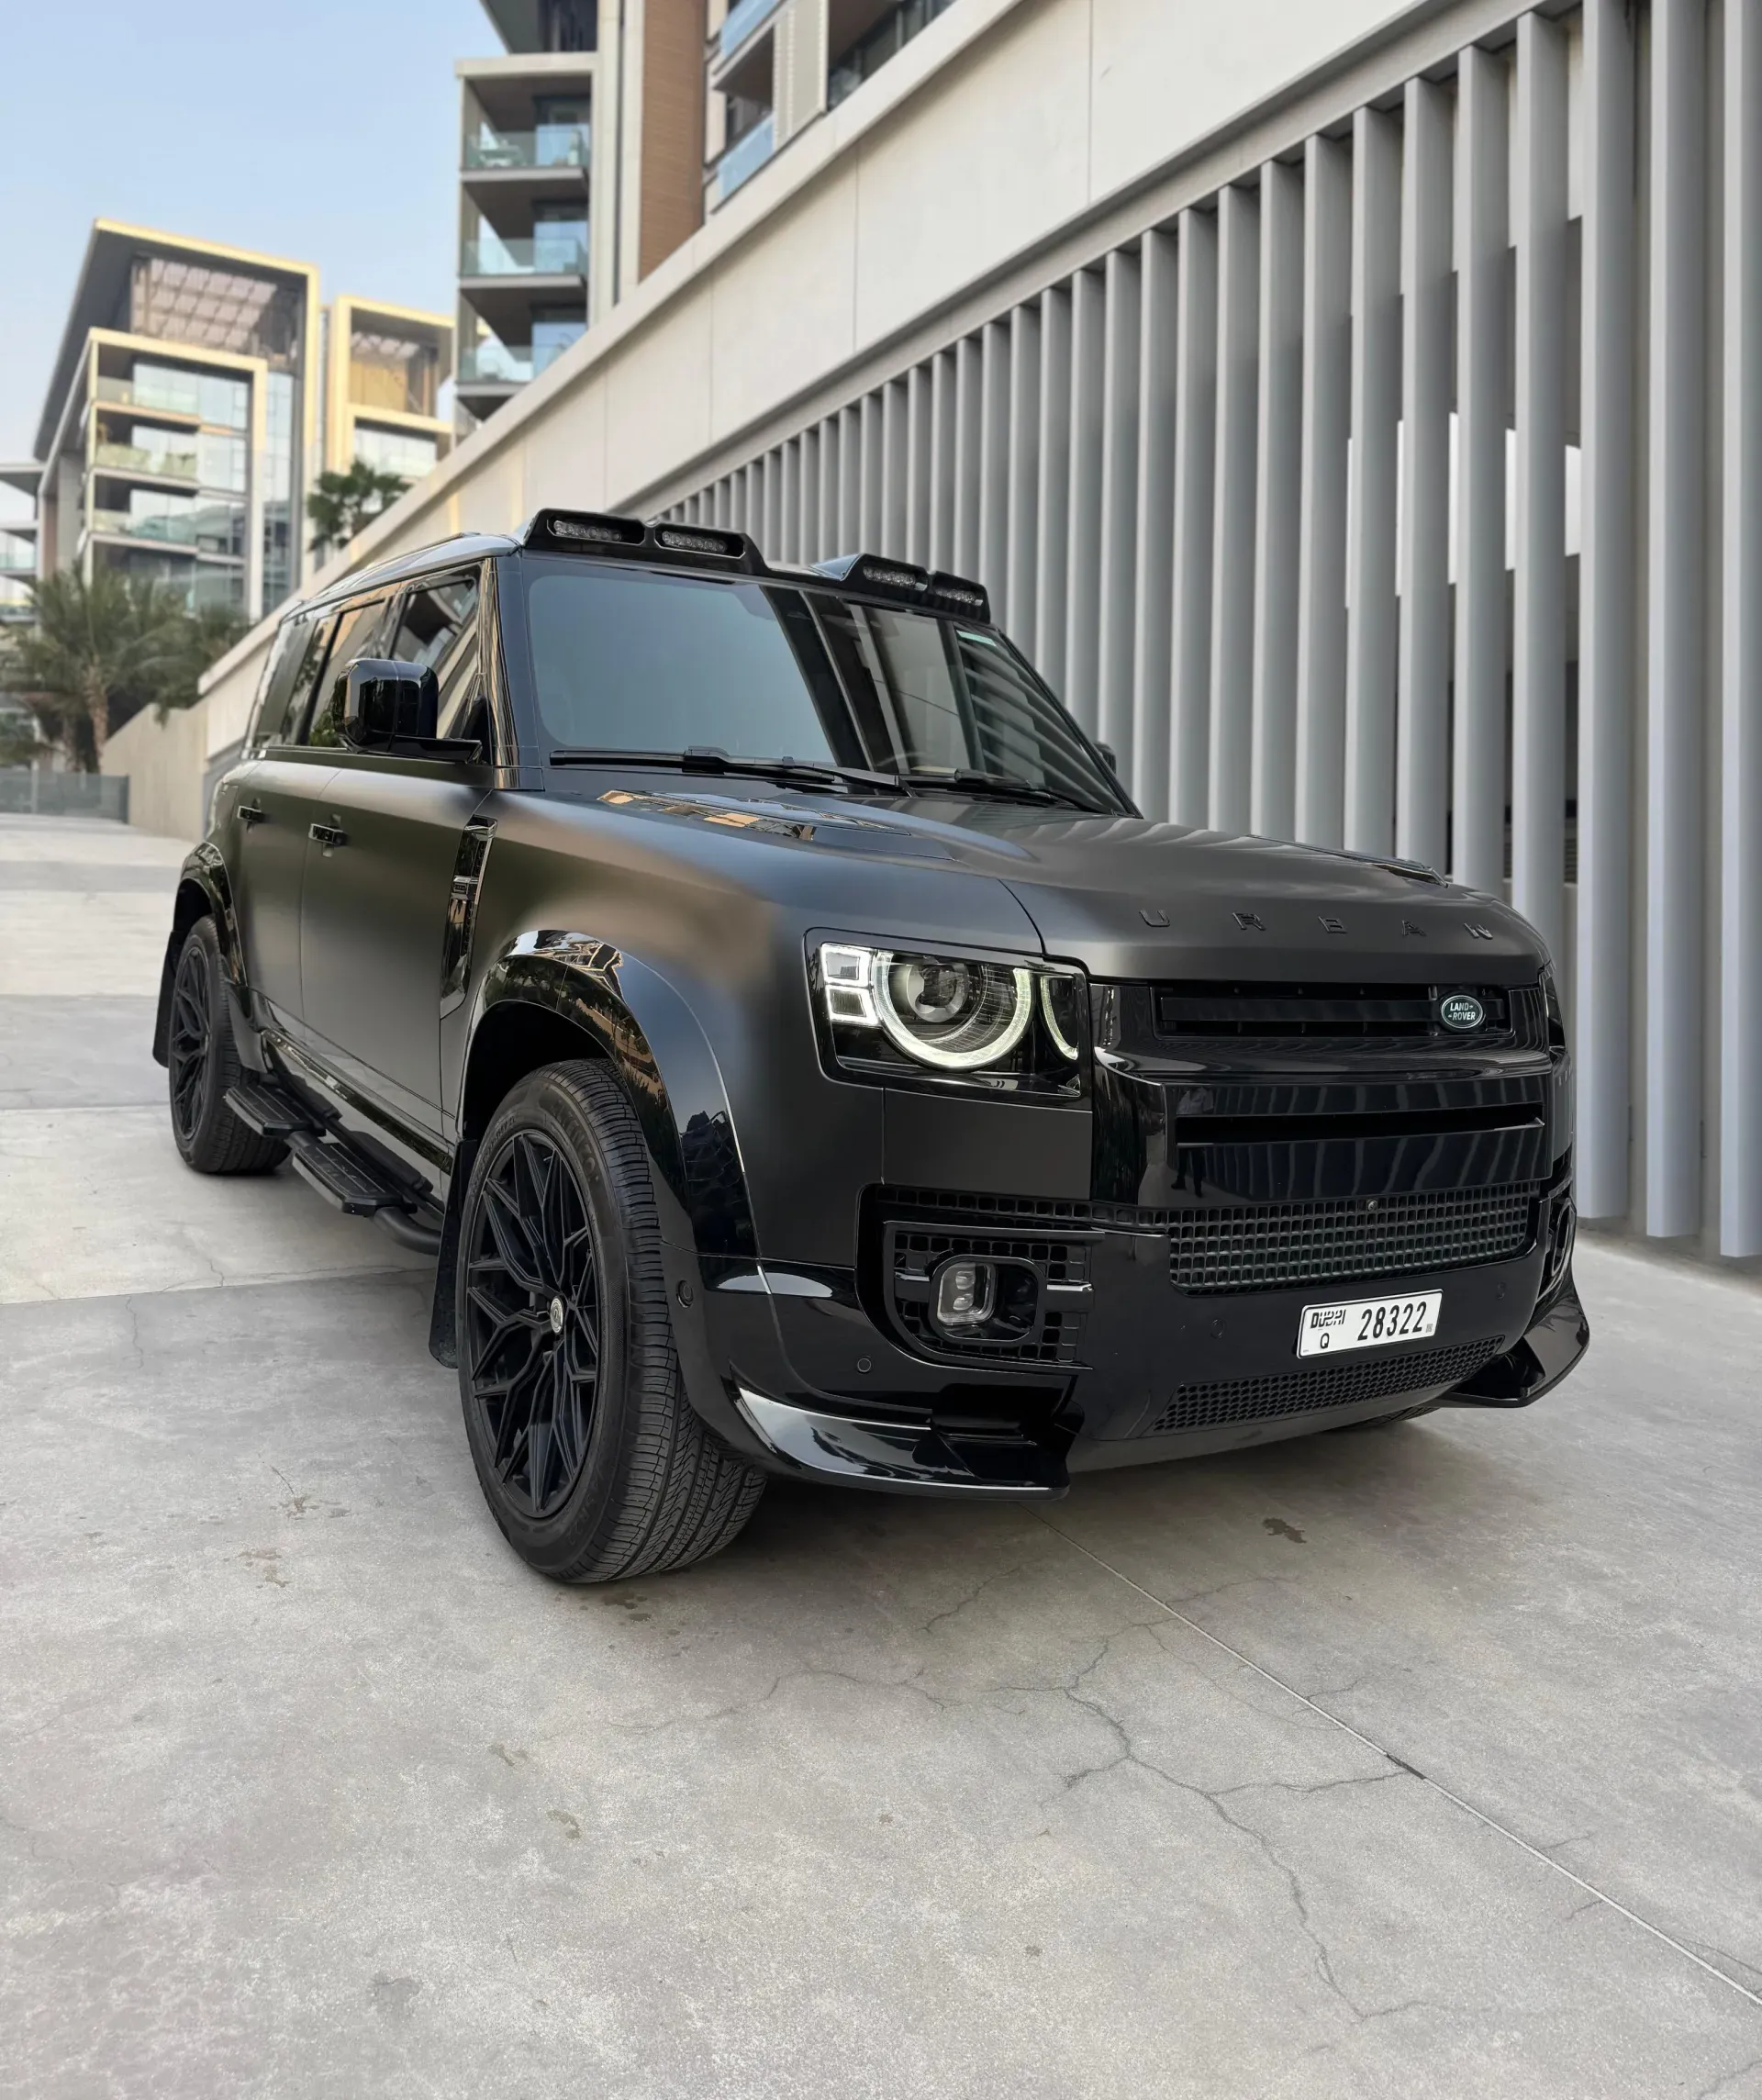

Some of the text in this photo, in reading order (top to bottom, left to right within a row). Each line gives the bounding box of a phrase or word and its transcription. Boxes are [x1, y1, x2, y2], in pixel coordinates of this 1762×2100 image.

[1138, 909, 1493, 941] URBAN
[1450, 1002, 1469, 1011] LAND
[1452, 1011, 1476, 1021] ROVER
[1310, 1301, 1427, 1341] DUBAI 28322
[1320, 1333, 1330, 1349] Q
